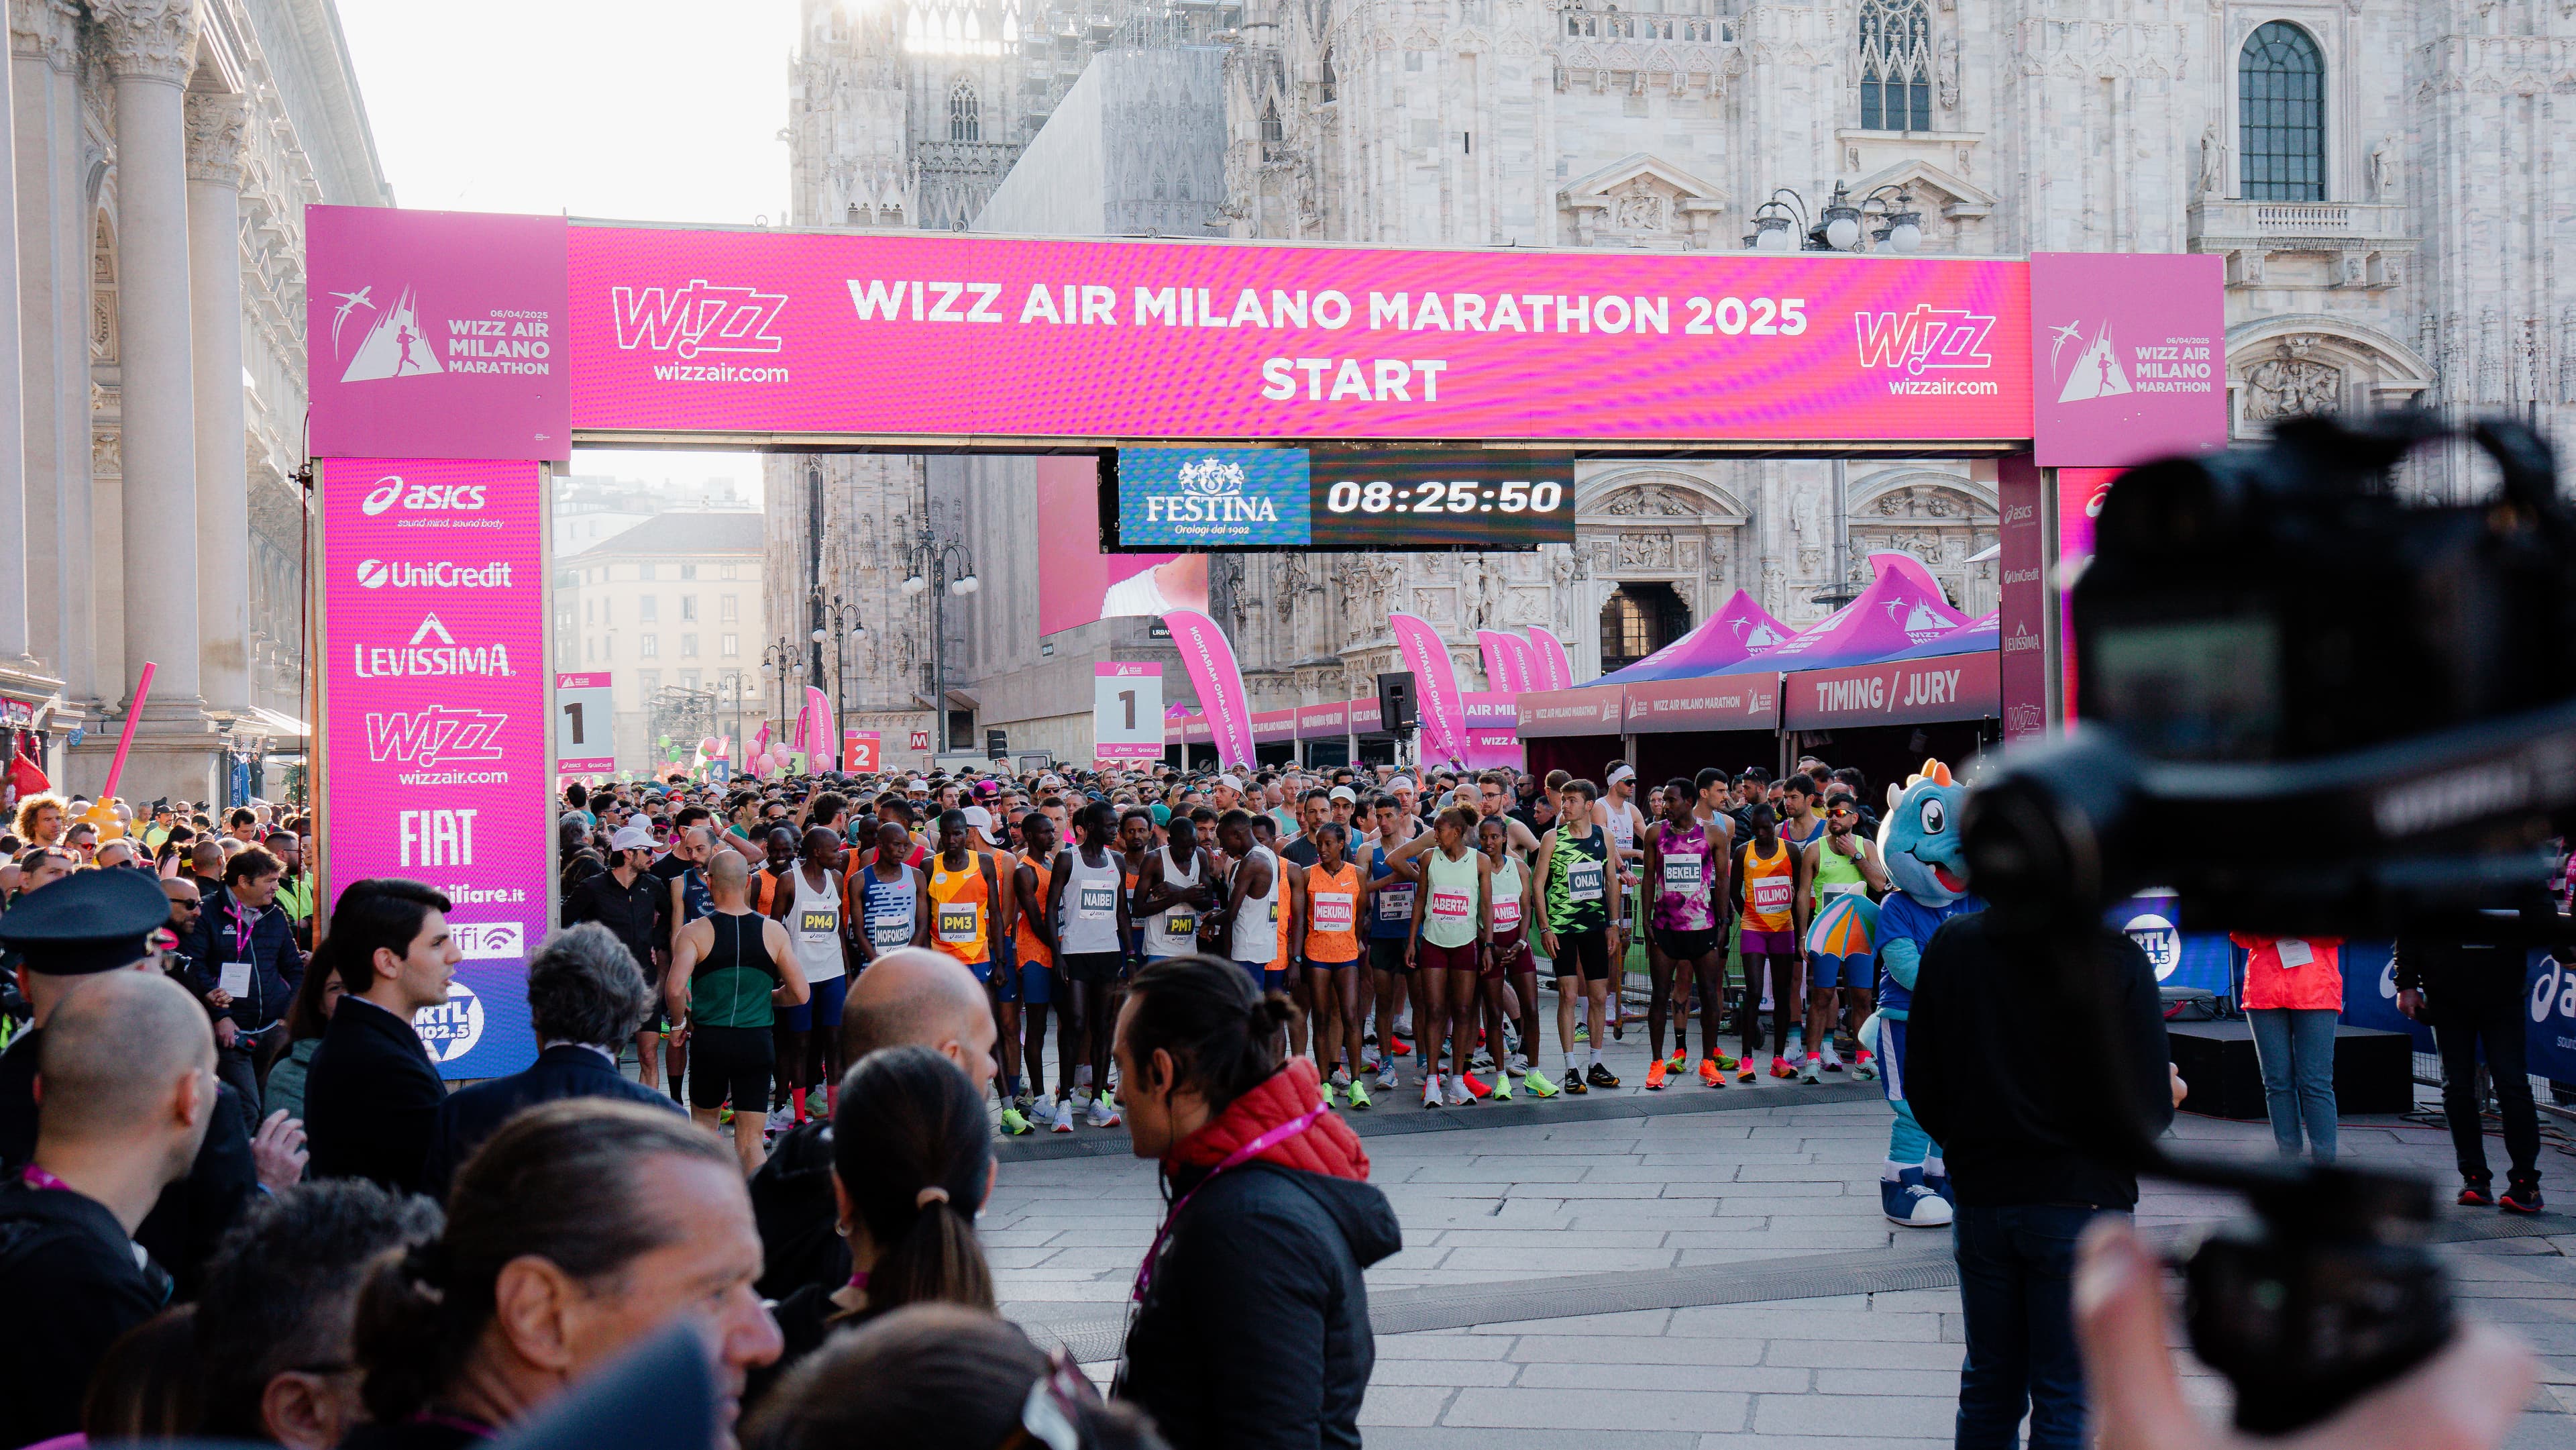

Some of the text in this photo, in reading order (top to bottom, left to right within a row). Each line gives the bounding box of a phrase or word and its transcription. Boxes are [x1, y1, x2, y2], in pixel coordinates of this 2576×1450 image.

[847, 279, 1807, 335] WIZZ AIR MILANO MARATHON 2025
[490, 311, 549, 319] 06/04/2025
[448, 320, 549, 338] WIZZ AIR
[448, 339, 550, 359] MILANO
[2135, 347, 2210, 360] WIZZ AIR
[448, 361, 549, 376] MARATHON
[654, 362, 789, 382] wizzair.com
[2136, 363, 2211, 378] MILANO
[1262, 357, 1447, 401] START
[1888, 377, 1998, 395] wizzair.com
[2136, 381, 2211, 393] MARATHON
[1328, 481, 1562, 513] 08:25:50
[1146, 496, 1278, 521] FESTINA
[397, 518, 504, 529] sound mind, sound body
[1175, 524, 1250, 537] Orologi dal 1902
[392, 562, 512, 588] UniCredit
[2012, 568, 2039, 582] UniCredit
[2005, 634, 2040, 652] LEVISSIMA
[356, 643, 511, 678] LEVISSIMA
[1816, 670, 1960, 713] TIMING / JURY
[1118, 690, 1135, 729] 1
[1466, 705, 1491, 715] AIR
[1653, 699, 1668, 711] WIZZ
[1669, 698, 1679, 710] AIR
[1680, 697, 1704, 709] MILANO
[1705, 696, 1740, 709] MARATHON
[1352, 711, 1362, 722] WIZZ
[1536, 709, 1547, 719] WIZZ
[1547, 708, 1555, 718] AIR
[1555, 707, 1571, 717] MILANO
[1572, 705, 1597, 717] MARATHON
[564, 703, 584, 744] 1
[912, 735, 927, 747] M
[854, 745, 869, 766] 2
[712, 764, 724, 778] 4
[785, 758, 796, 774] 3
[399, 770, 508, 785] wizzair.com
[400, 809, 478, 867] FIAT
[1574, 874, 1599, 888] ONAL
[1666, 867, 1699, 880] BEKELE
[1084, 893, 1112, 907] NAIBEI
[1758, 889, 1788, 902] KILIMO
[1317, 906, 1350, 919] MEKURIA
[1433, 897, 1467, 913] ABERTA
[806, 915, 833, 929] PM4
[945, 917, 972, 929] PM3
[1171, 919, 1191, 932] PM1
[453, 927, 478, 950] ifi
[2148, 952, 2170, 964] 2.5
[416, 1001, 468, 1024] RTL
[416, 1025, 470, 1039] 102.5
